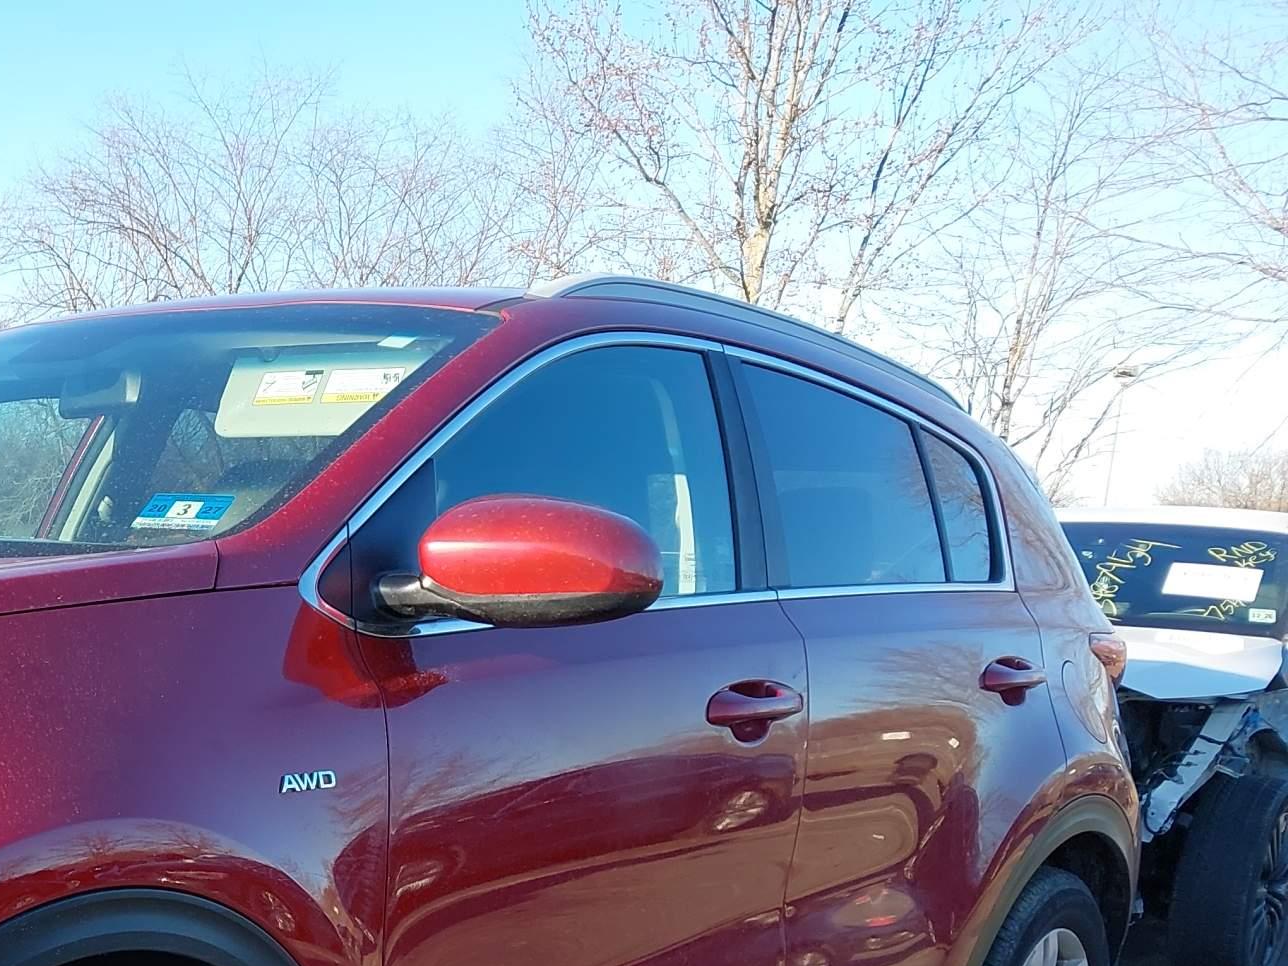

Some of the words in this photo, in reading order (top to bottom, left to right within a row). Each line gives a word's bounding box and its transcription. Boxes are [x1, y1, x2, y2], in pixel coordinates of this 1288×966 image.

[176, 503, 191, 516] 3
[200, 506, 224, 515] 27
[280, 770, 336, 793] AWD
